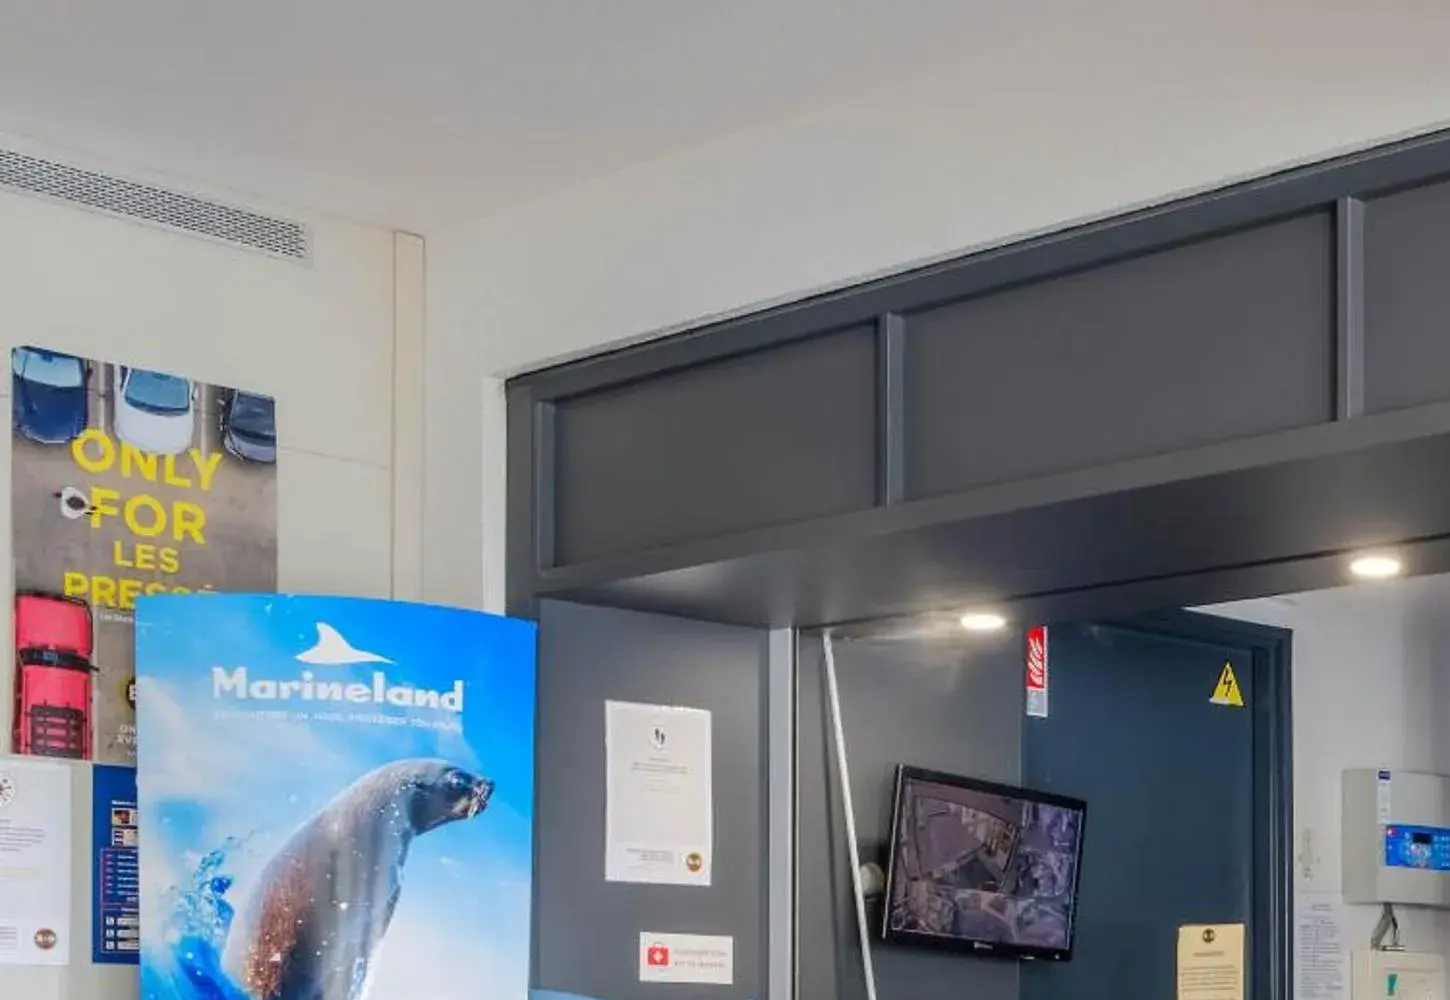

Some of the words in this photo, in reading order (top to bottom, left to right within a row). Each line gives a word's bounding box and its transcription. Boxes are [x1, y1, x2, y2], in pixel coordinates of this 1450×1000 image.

[71, 428, 222, 491] ONLY
[90, 486, 206, 543] FOR
[113, 540, 180, 573] LES
[212, 666, 464, 712] Marineland
